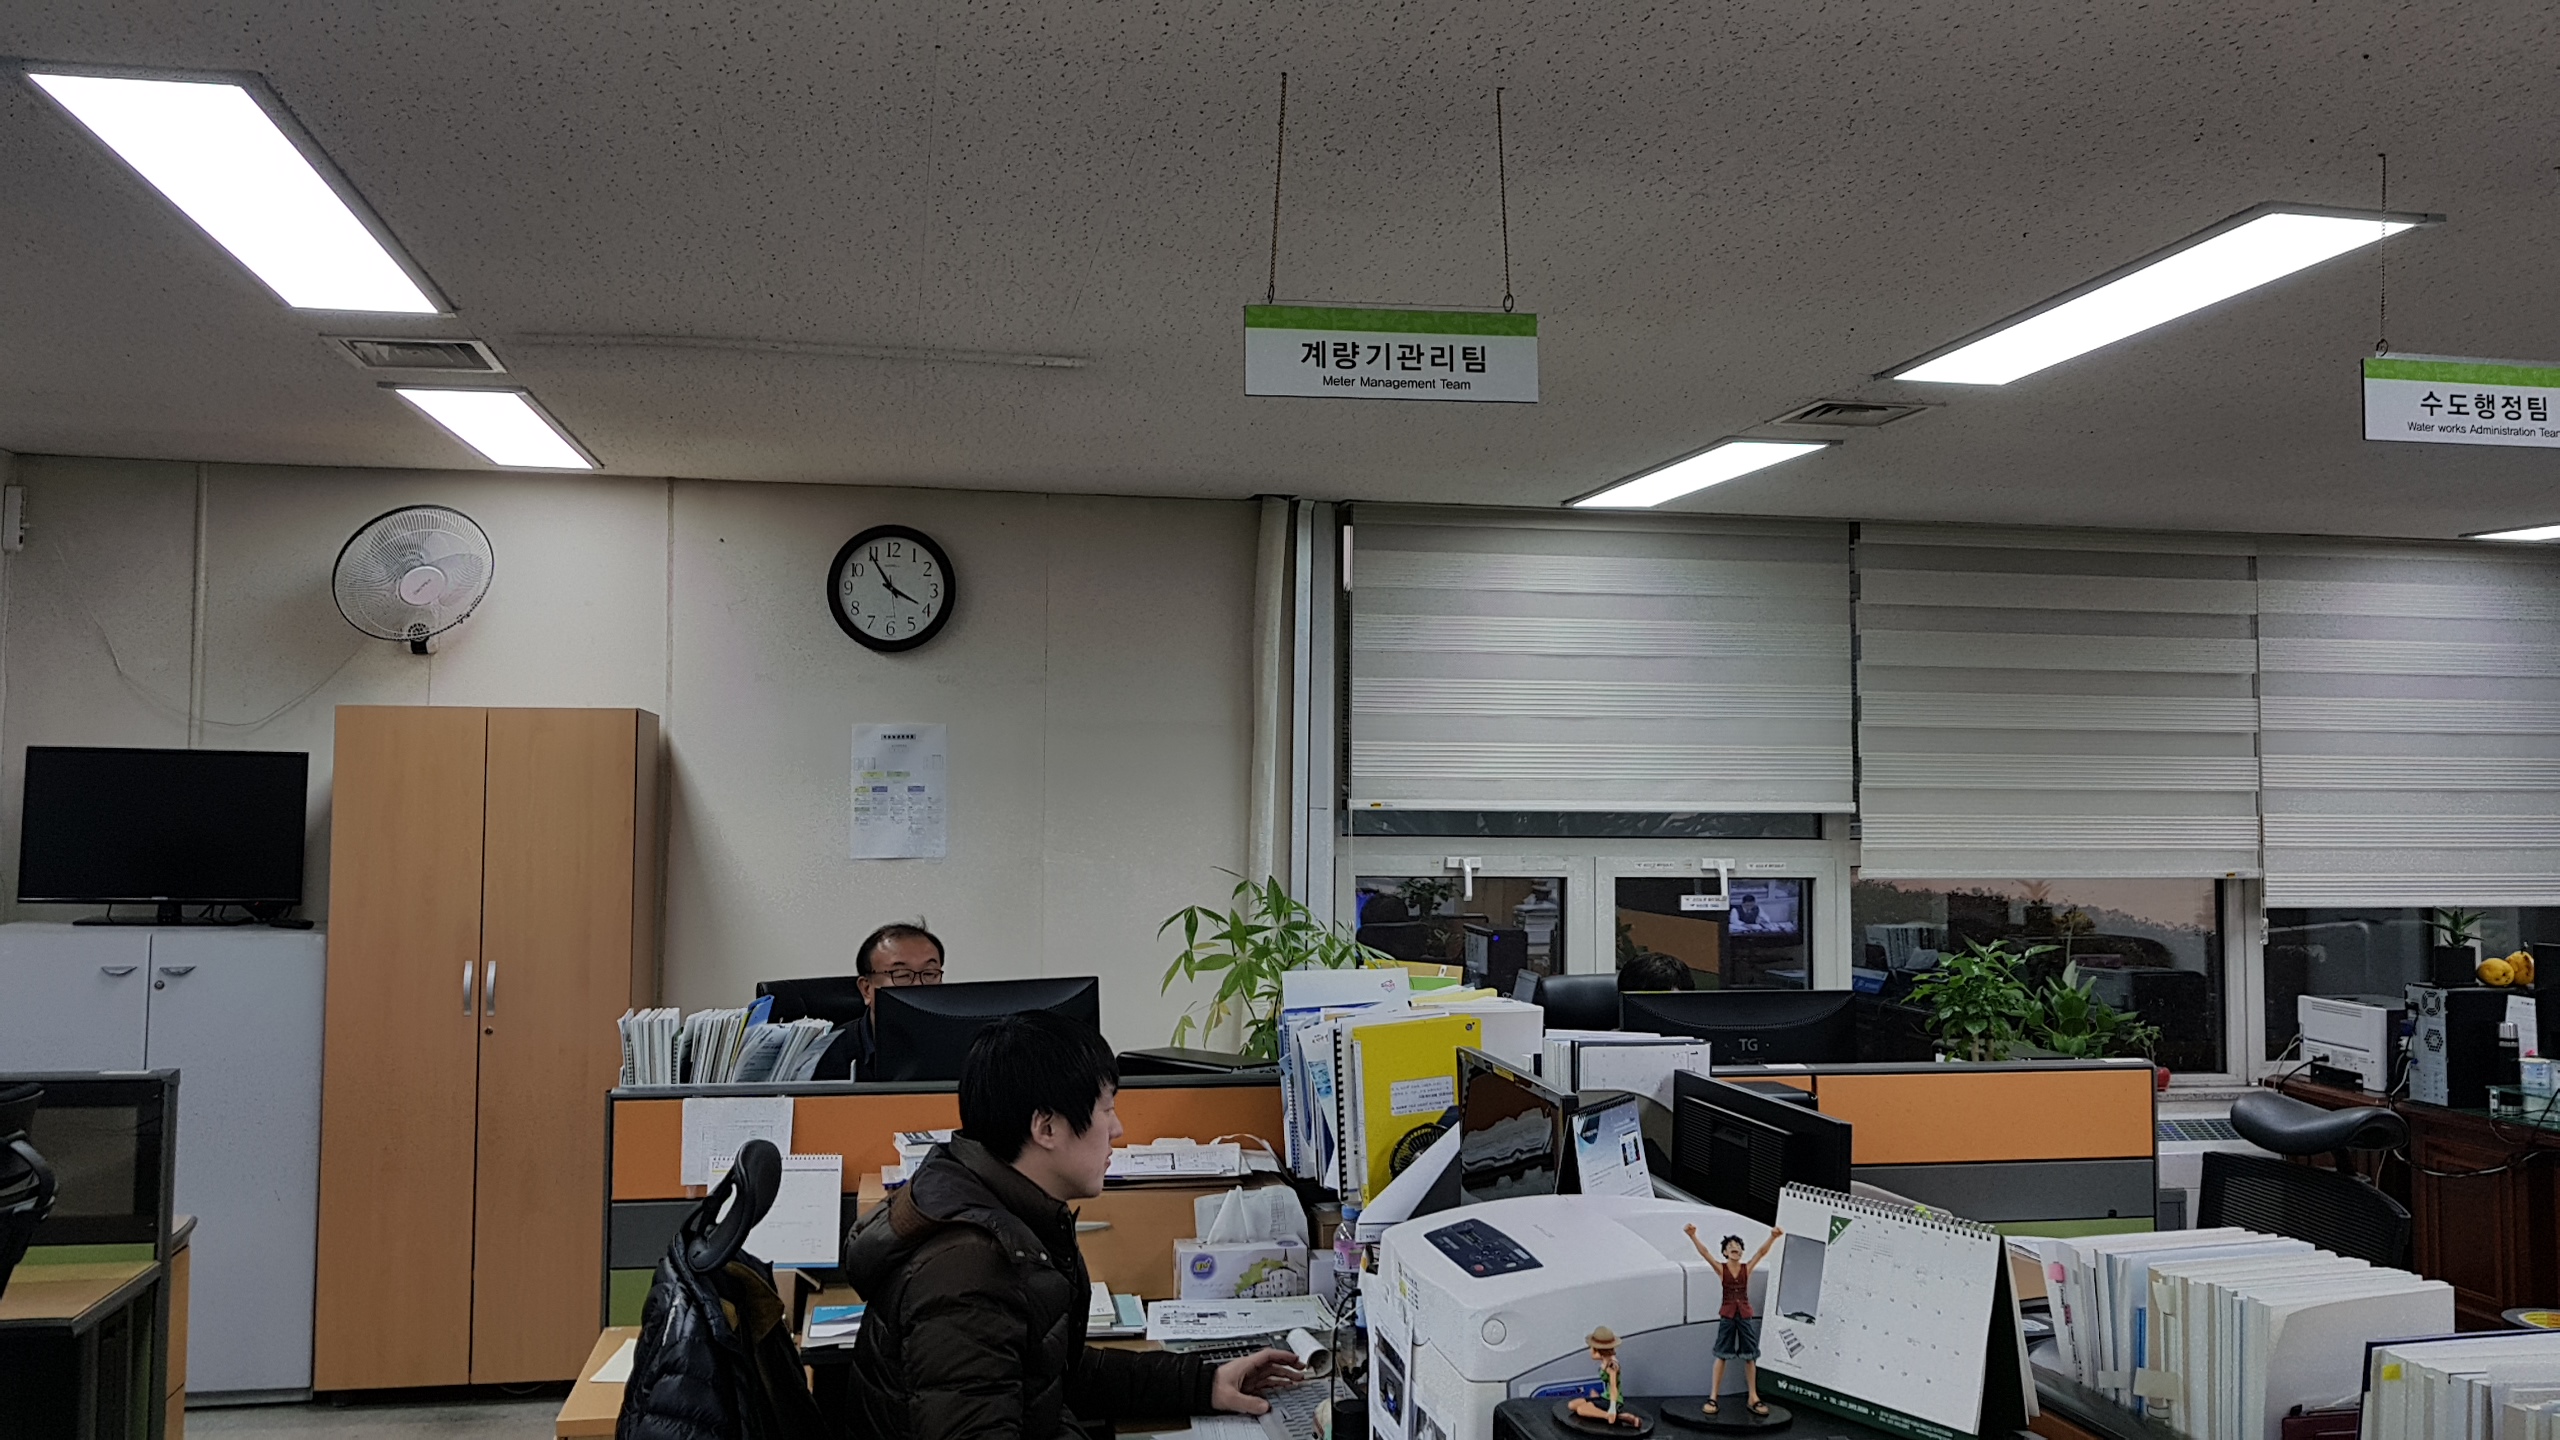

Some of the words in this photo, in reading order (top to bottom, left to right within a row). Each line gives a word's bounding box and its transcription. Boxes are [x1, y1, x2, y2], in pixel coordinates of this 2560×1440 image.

[1300, 340, 1487, 373] 계량기관리팀
[1322, 375, 1356, 387] Meter
[1360, 376, 1436, 390] Management
[1440, 378, 1471, 390] Team
[2420, 391, 2547, 421] 수도행정팀
[2407, 421, 2435, 432] Water
[2438, 423, 2466, 434] works
[2469, 424, 2536, 437] Administration
[886, 542, 901, 558] 12
[851, 563, 864, 577] 10
[923, 561, 932, 577] 2
[844, 580, 853, 595] 9
[930, 583, 939, 599] 3
[850, 600, 860, 616] 8
[922, 603, 930, 617] 4
[867, 615, 876, 629] 7
[886, 621, 895, 636] 6
[907, 616, 916, 631] 5
[1738, 1038, 1758, 1051] TG
